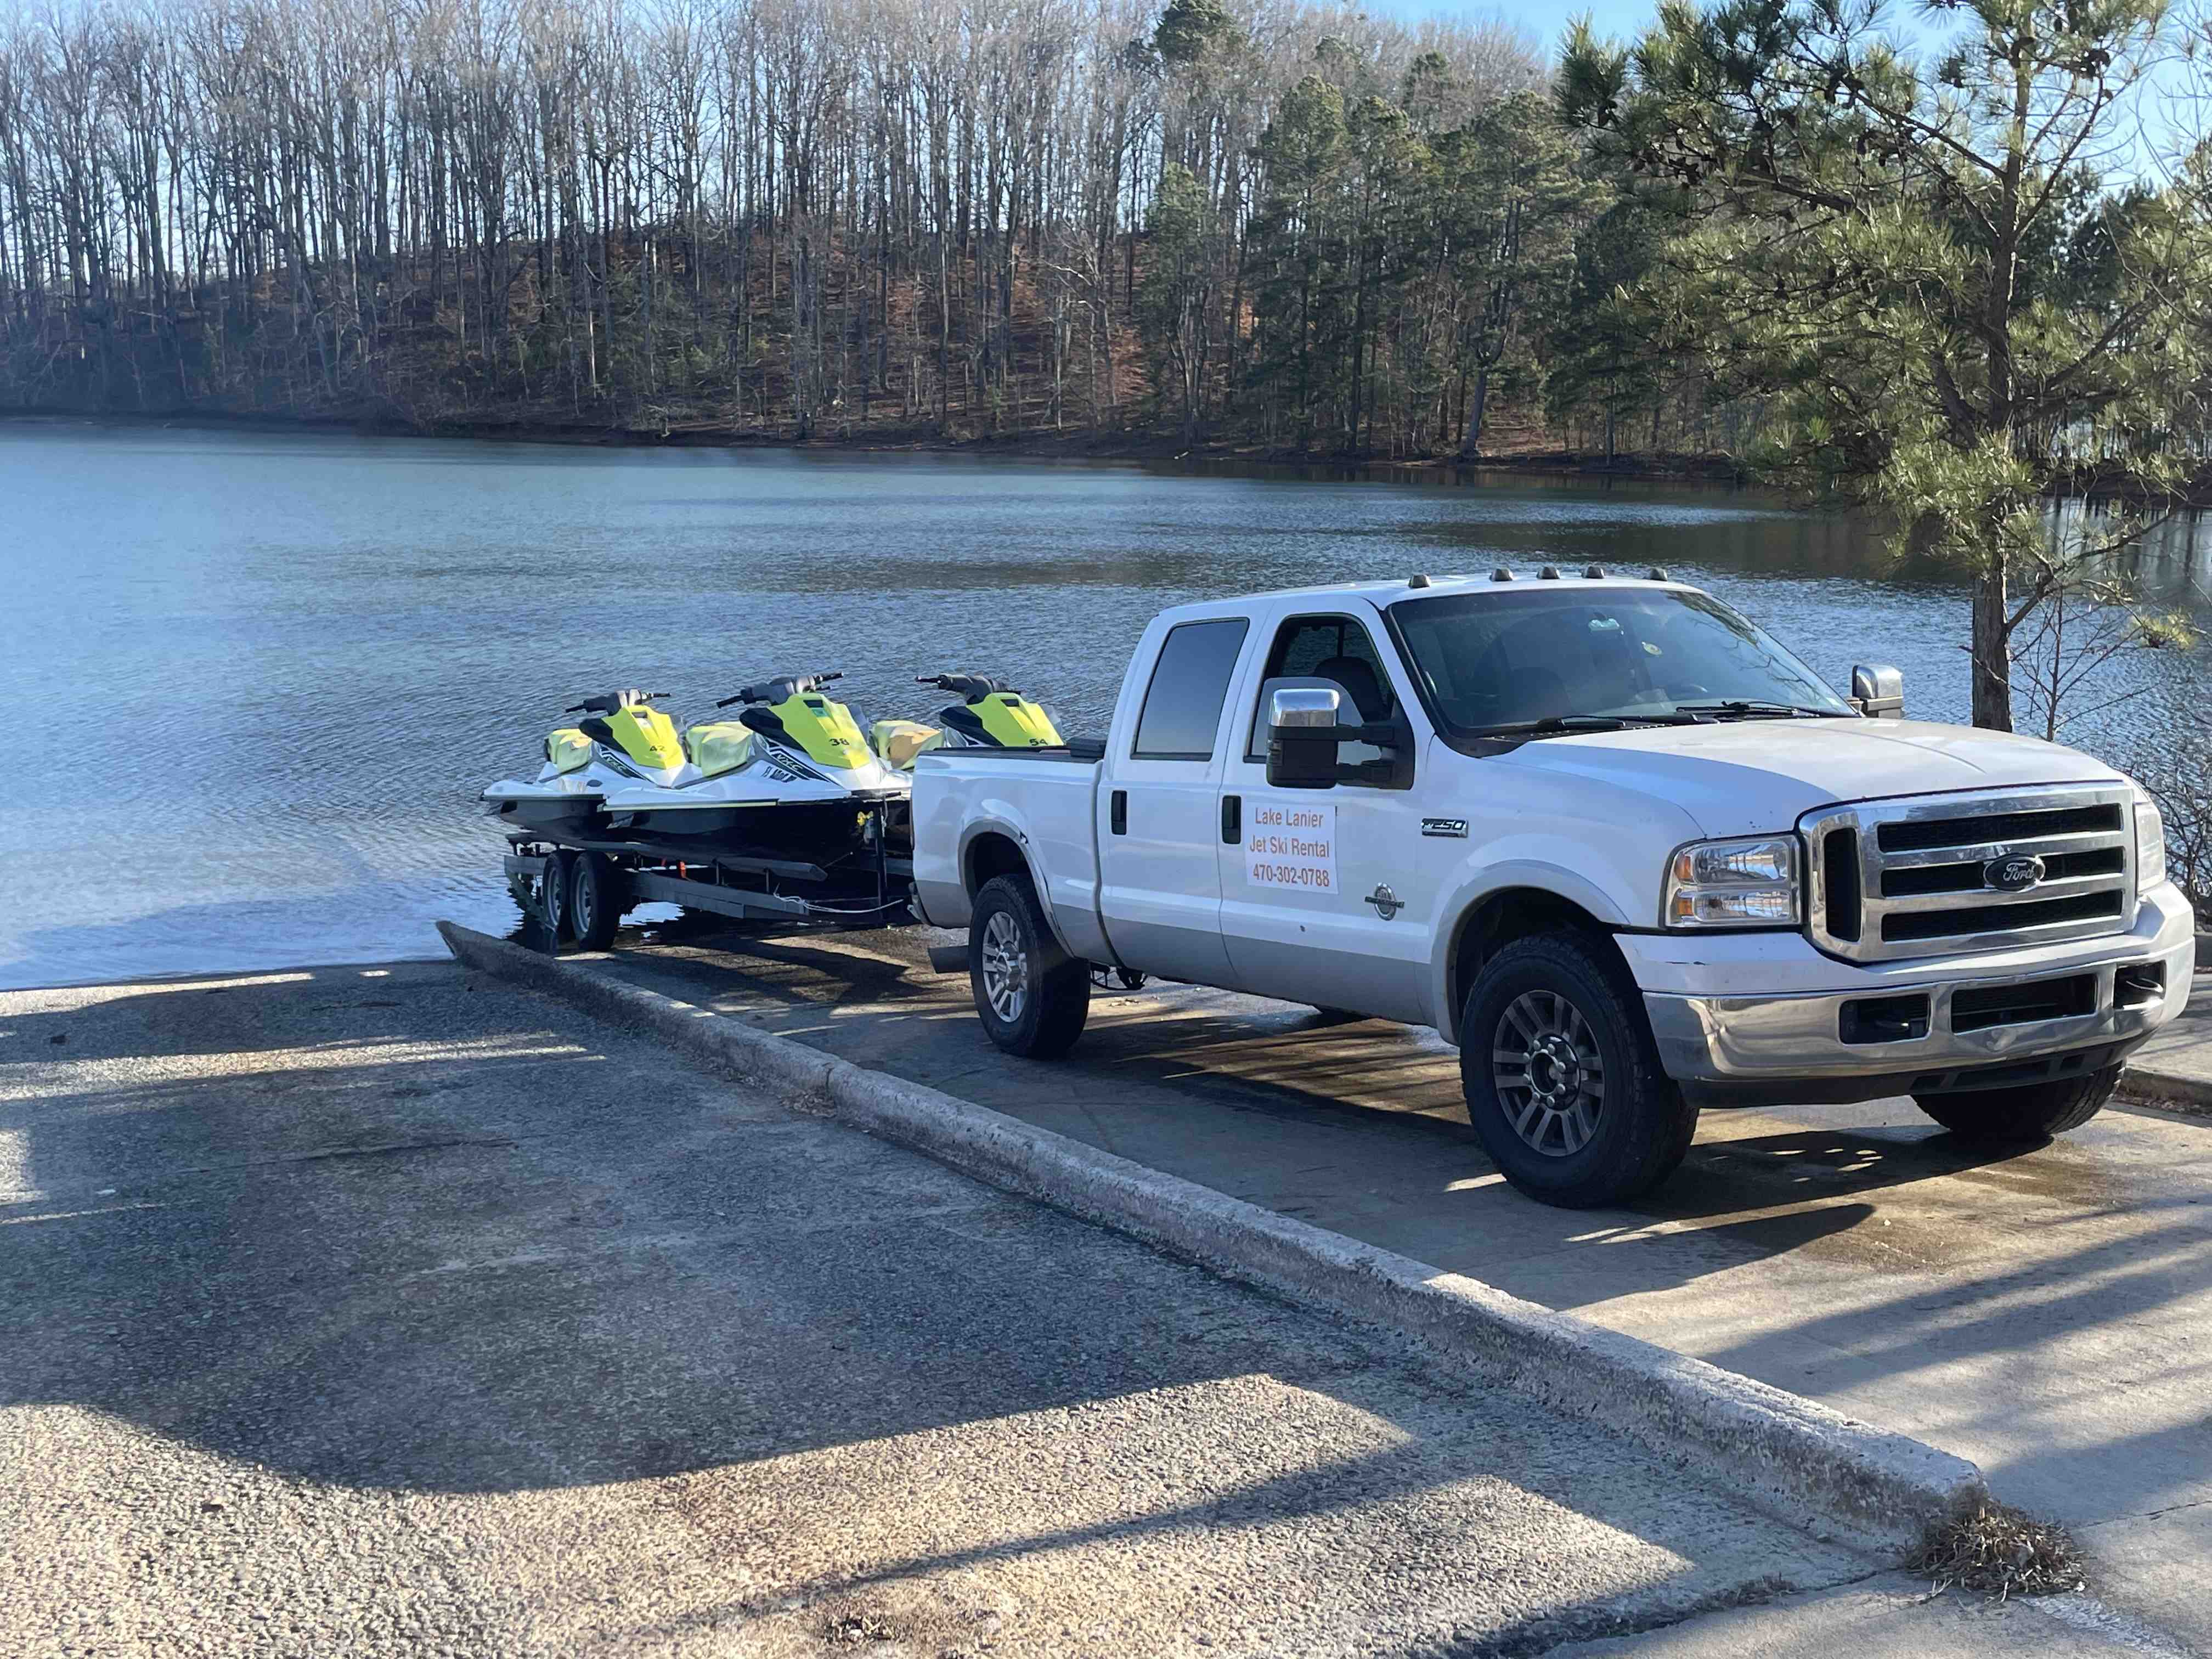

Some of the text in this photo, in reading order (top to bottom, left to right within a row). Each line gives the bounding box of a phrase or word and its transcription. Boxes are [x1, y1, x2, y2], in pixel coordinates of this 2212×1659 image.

[829, 737, 850, 746] 38
[1029, 738, 1048, 746] 54
[1255, 808, 1324, 828] Lake Lanier
[1250, 835, 1330, 857] Jet Ski Rental
[1253, 864, 1330, 887] 470-302-0788
[2003, 862, 2035, 882] Ford
